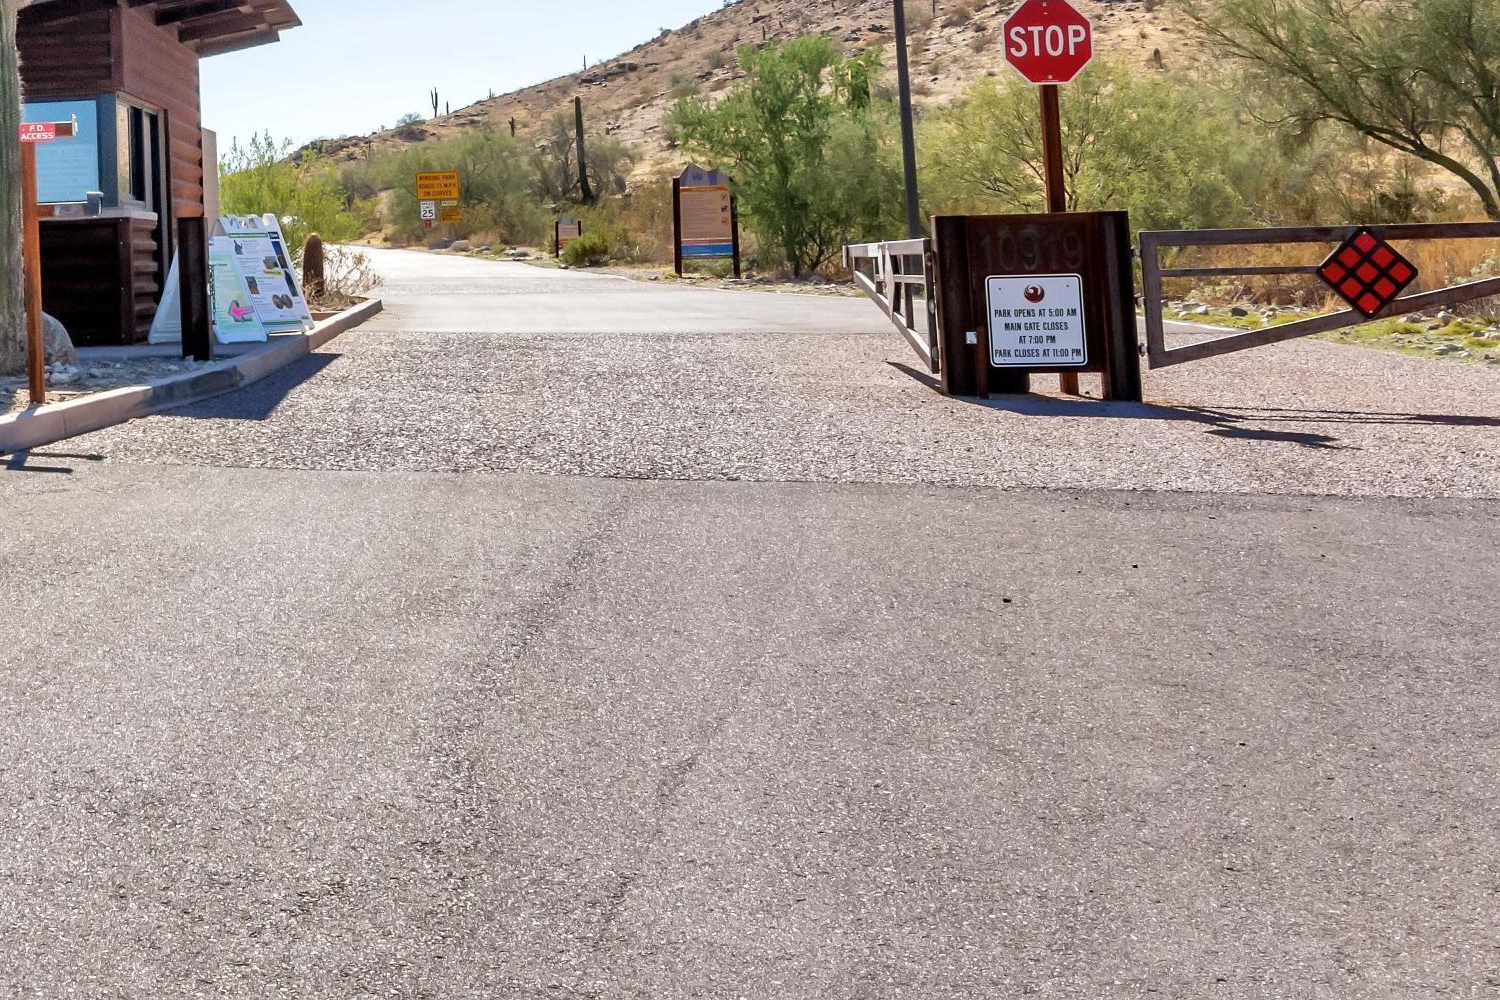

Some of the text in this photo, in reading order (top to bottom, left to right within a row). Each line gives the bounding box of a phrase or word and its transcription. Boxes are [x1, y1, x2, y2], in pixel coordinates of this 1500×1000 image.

[1010, 25, 1086, 57] STOP
[422, 209, 434, 217] 25
[994, 308, 1077, 318] PARK OPENS AT 5:00 AM
[1004, 321, 1069, 331] MAIN GATE CLOSES
[1018, 335, 1056, 344] AT 7:00 PM
[994, 348, 1082, 358] PARK CLOSES AT 11:00 PM
